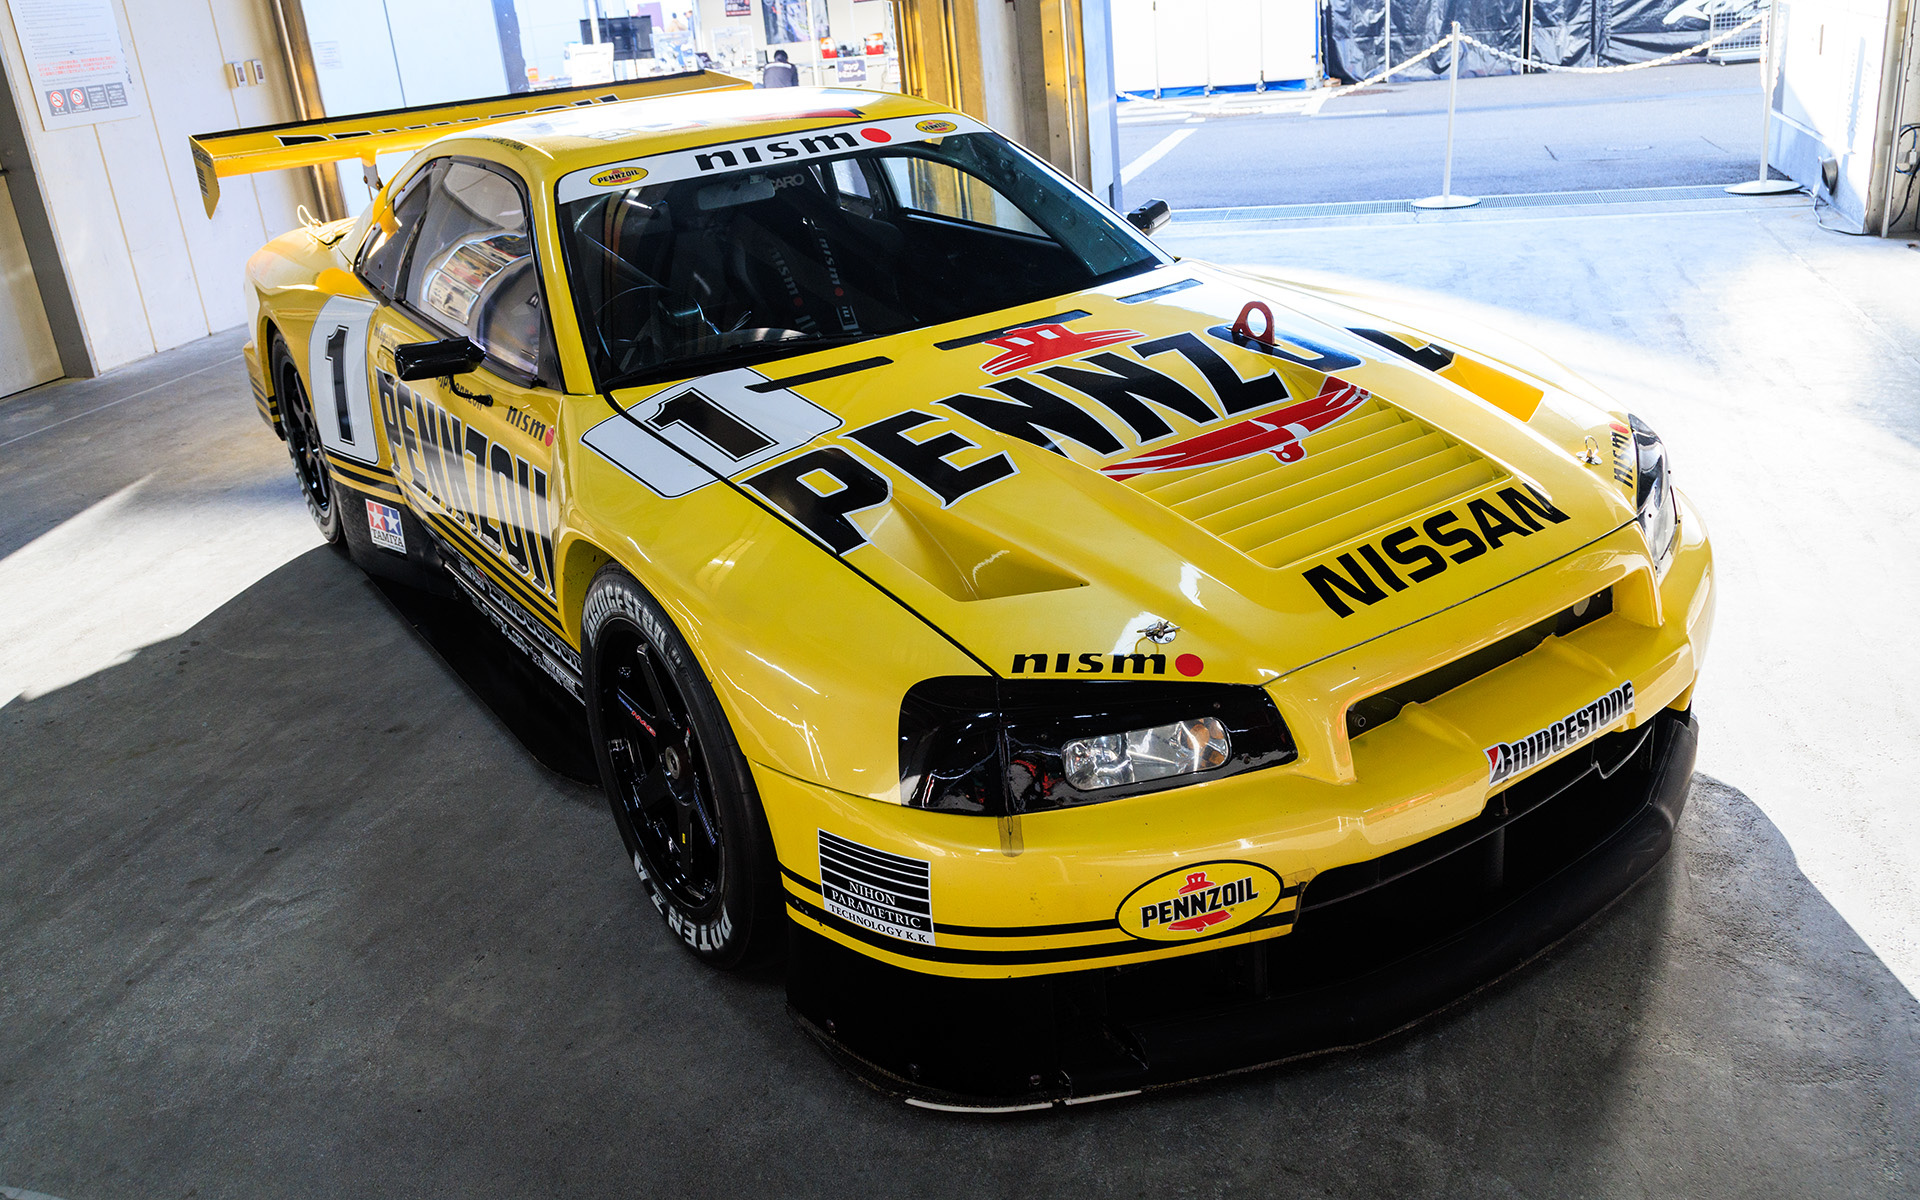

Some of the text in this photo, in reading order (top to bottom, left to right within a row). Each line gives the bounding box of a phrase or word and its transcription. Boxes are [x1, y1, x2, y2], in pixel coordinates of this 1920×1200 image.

[597, 169, 640, 184] PENNZOIL
[325, 325, 356, 447] 1
[644, 387, 780, 463] 1
[371, 528, 404, 548] TAMIYA
[1301, 483, 1571, 619] NISSAN
[1489, 682, 1634, 782] BRIDGESTONE
[831, 889, 922, 929] PARAMETRIC
[848, 880, 897, 906] NIHON
[1140, 876, 1259, 929] PENNZOIL
[829, 903, 931, 944] TECHNOLOGY K.K.
